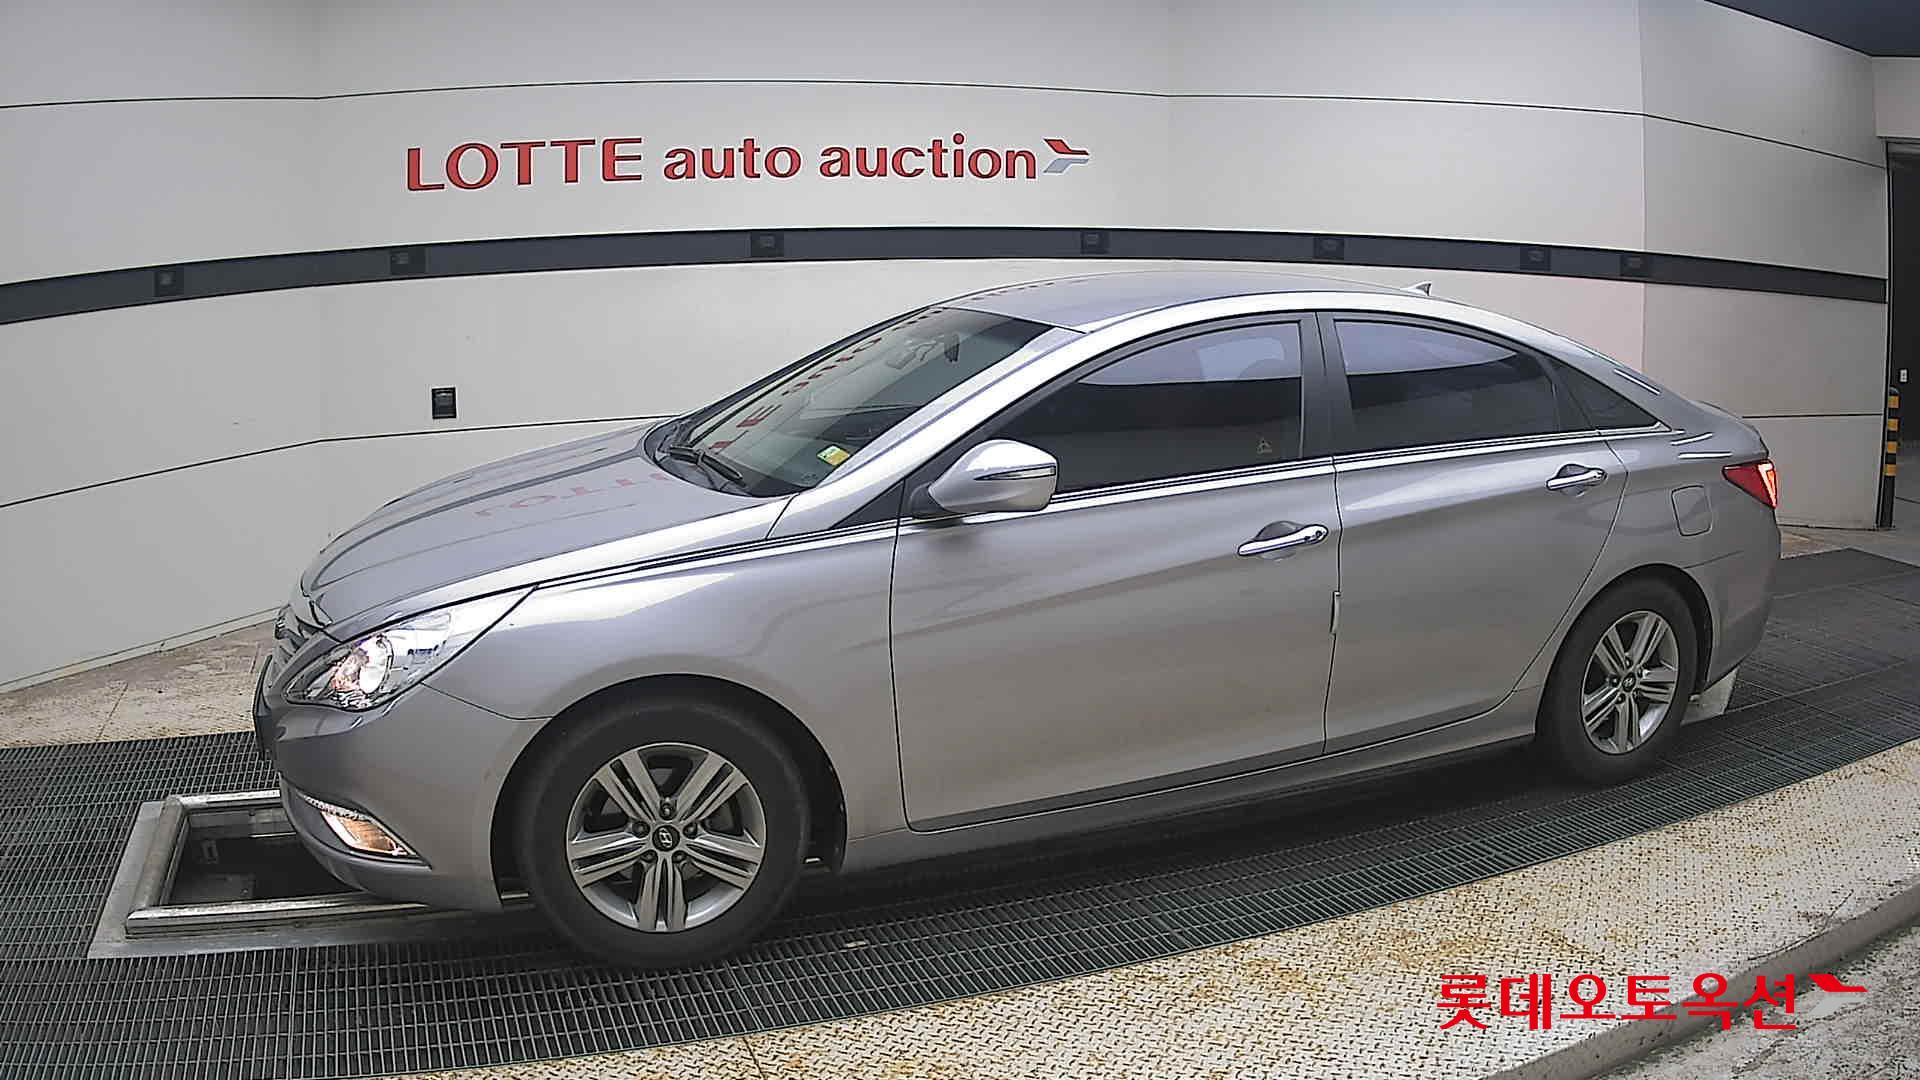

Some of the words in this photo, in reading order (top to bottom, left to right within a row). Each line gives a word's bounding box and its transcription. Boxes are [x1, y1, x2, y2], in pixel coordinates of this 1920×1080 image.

[407, 137, 642, 190] LOTTE
[664, 138, 801, 180] auto
[819, 134, 1037, 178] auction
